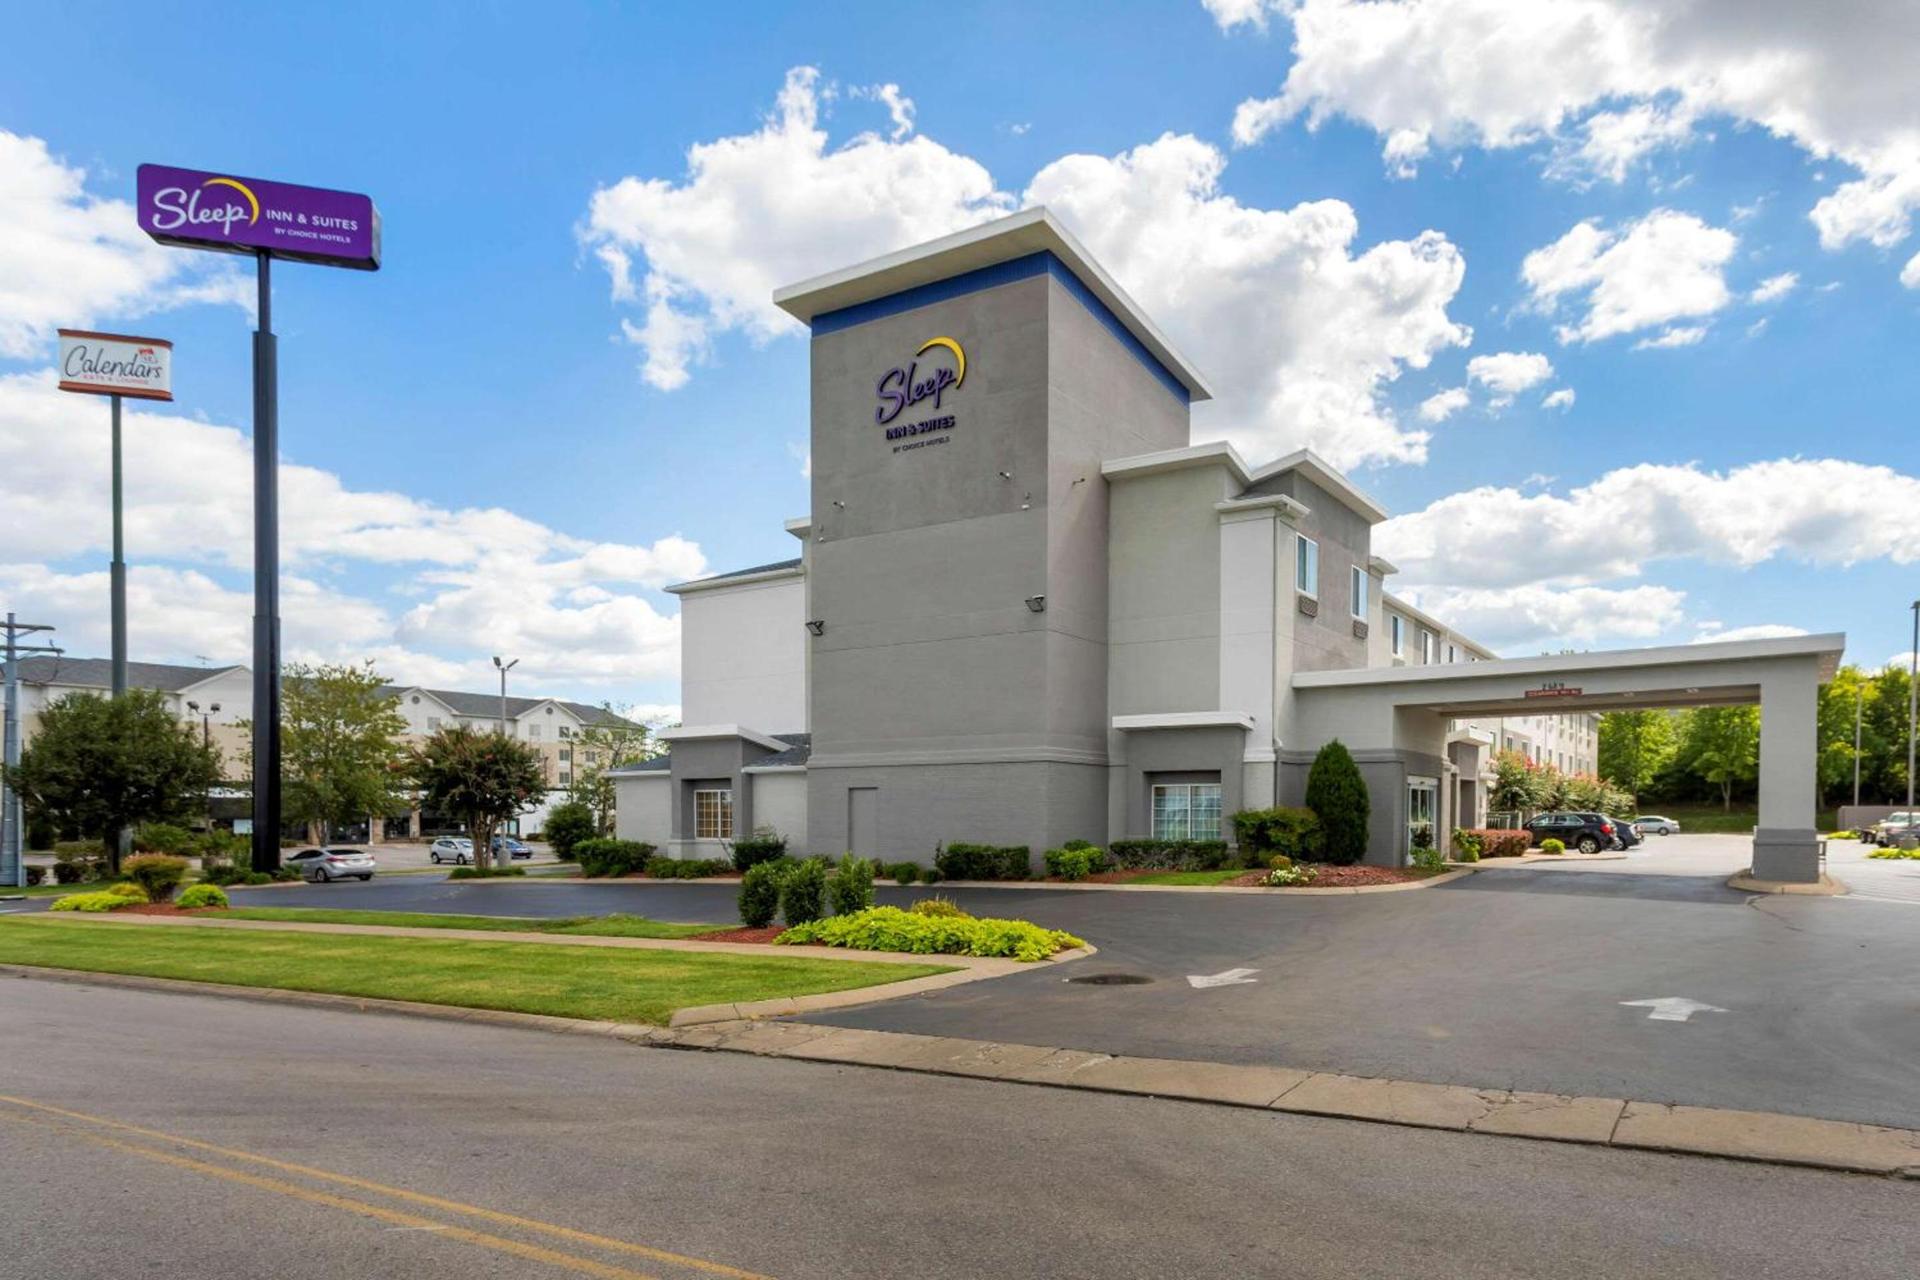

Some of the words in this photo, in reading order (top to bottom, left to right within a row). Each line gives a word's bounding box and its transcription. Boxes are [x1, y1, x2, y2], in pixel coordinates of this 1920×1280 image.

[152, 187, 249, 235] Sleep
[266, 209, 293, 222] INN
[297, 213, 307, 224] &
[311, 215, 358, 231] SUITES
[287, 229, 318, 240] CHOICE
[320, 232, 351, 243] HOTELS
[65, 345, 163, 378] Calendars
[876, 361, 957, 424] Sleep
[886, 425, 907, 440] INN
[908, 423, 917, 436] &
[918, 415, 956, 433] SUITES
[902, 440, 925, 452] CHOICE
[926, 436, 951, 446] HOTELS
